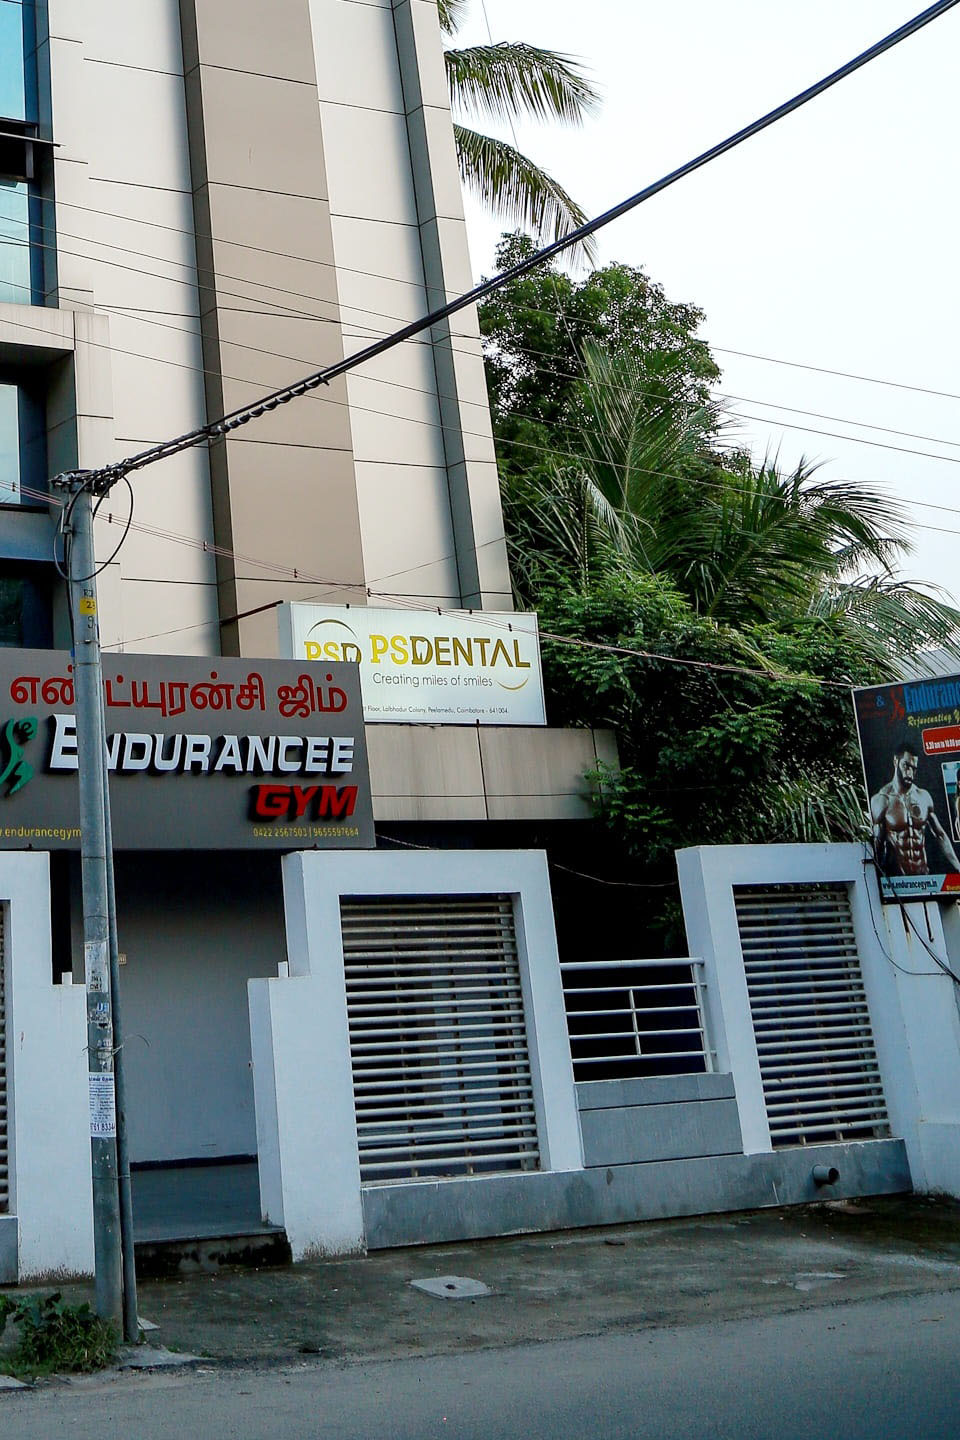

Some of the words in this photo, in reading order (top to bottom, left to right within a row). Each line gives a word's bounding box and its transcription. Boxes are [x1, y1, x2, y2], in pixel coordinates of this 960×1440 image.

[304, 641, 362, 664] PSD
[372, 672, 420, 688] Creating
[422, 674, 448, 687] miles
[450, 675, 461, 687] of
[463, 675, 493, 688] smiles
[277, 673, 348, 719] ஜிம்
[255, 783, 359, 817] GYM
[252, 827, 273, 838] 0422
